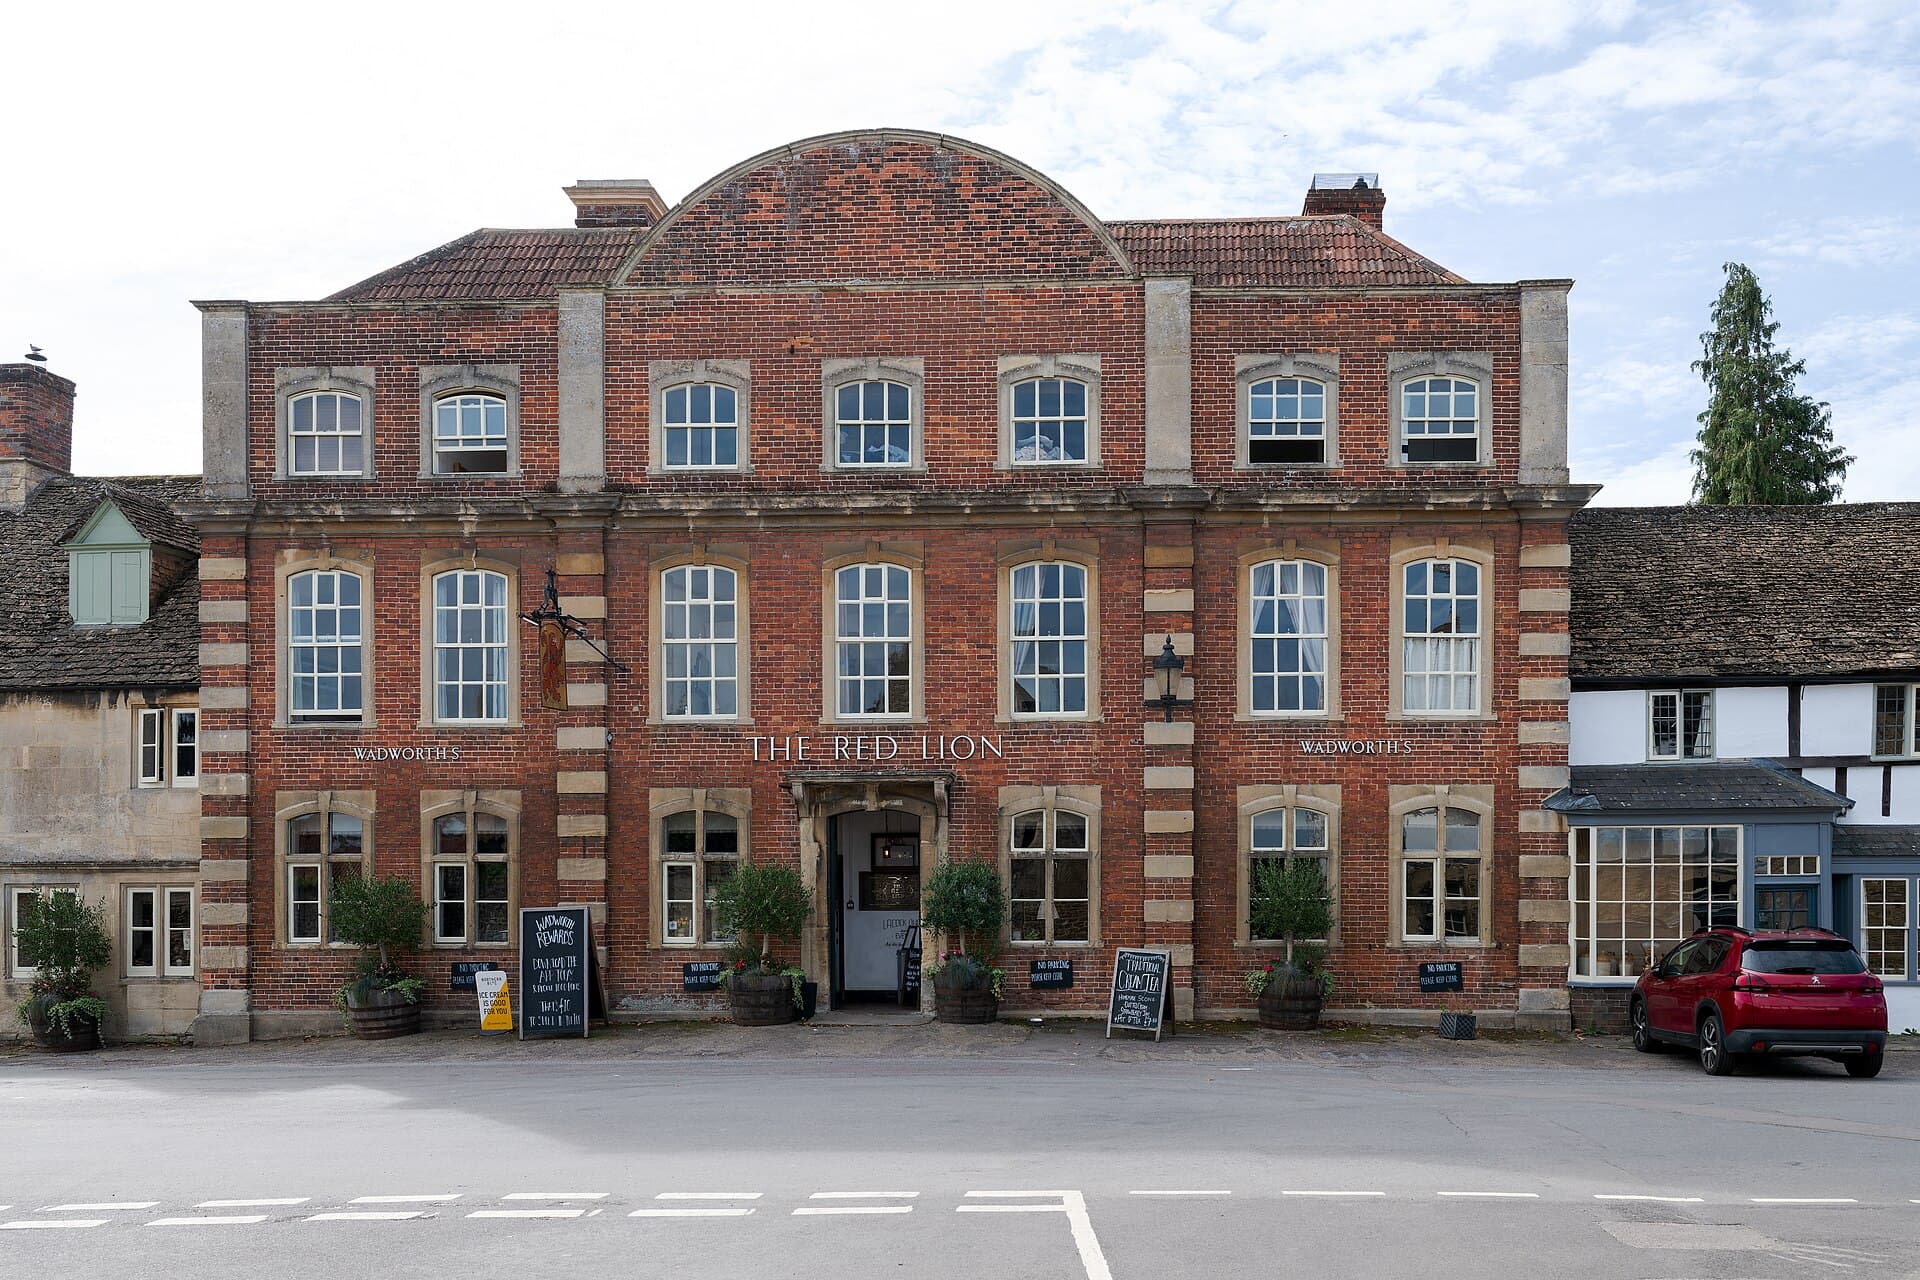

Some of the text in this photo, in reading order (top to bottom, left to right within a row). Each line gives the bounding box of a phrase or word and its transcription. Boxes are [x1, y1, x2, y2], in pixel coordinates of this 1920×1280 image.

[746, 735, 1003, 761] THE RED LION
[536, 915, 576, 931] WADWORTH
[536, 929, 575, 949] REWARDS
[1037, 961, 1046, 969] NO
[1142, 973, 1160, 992] TEA
[490, 991, 509, 999] CREAM
